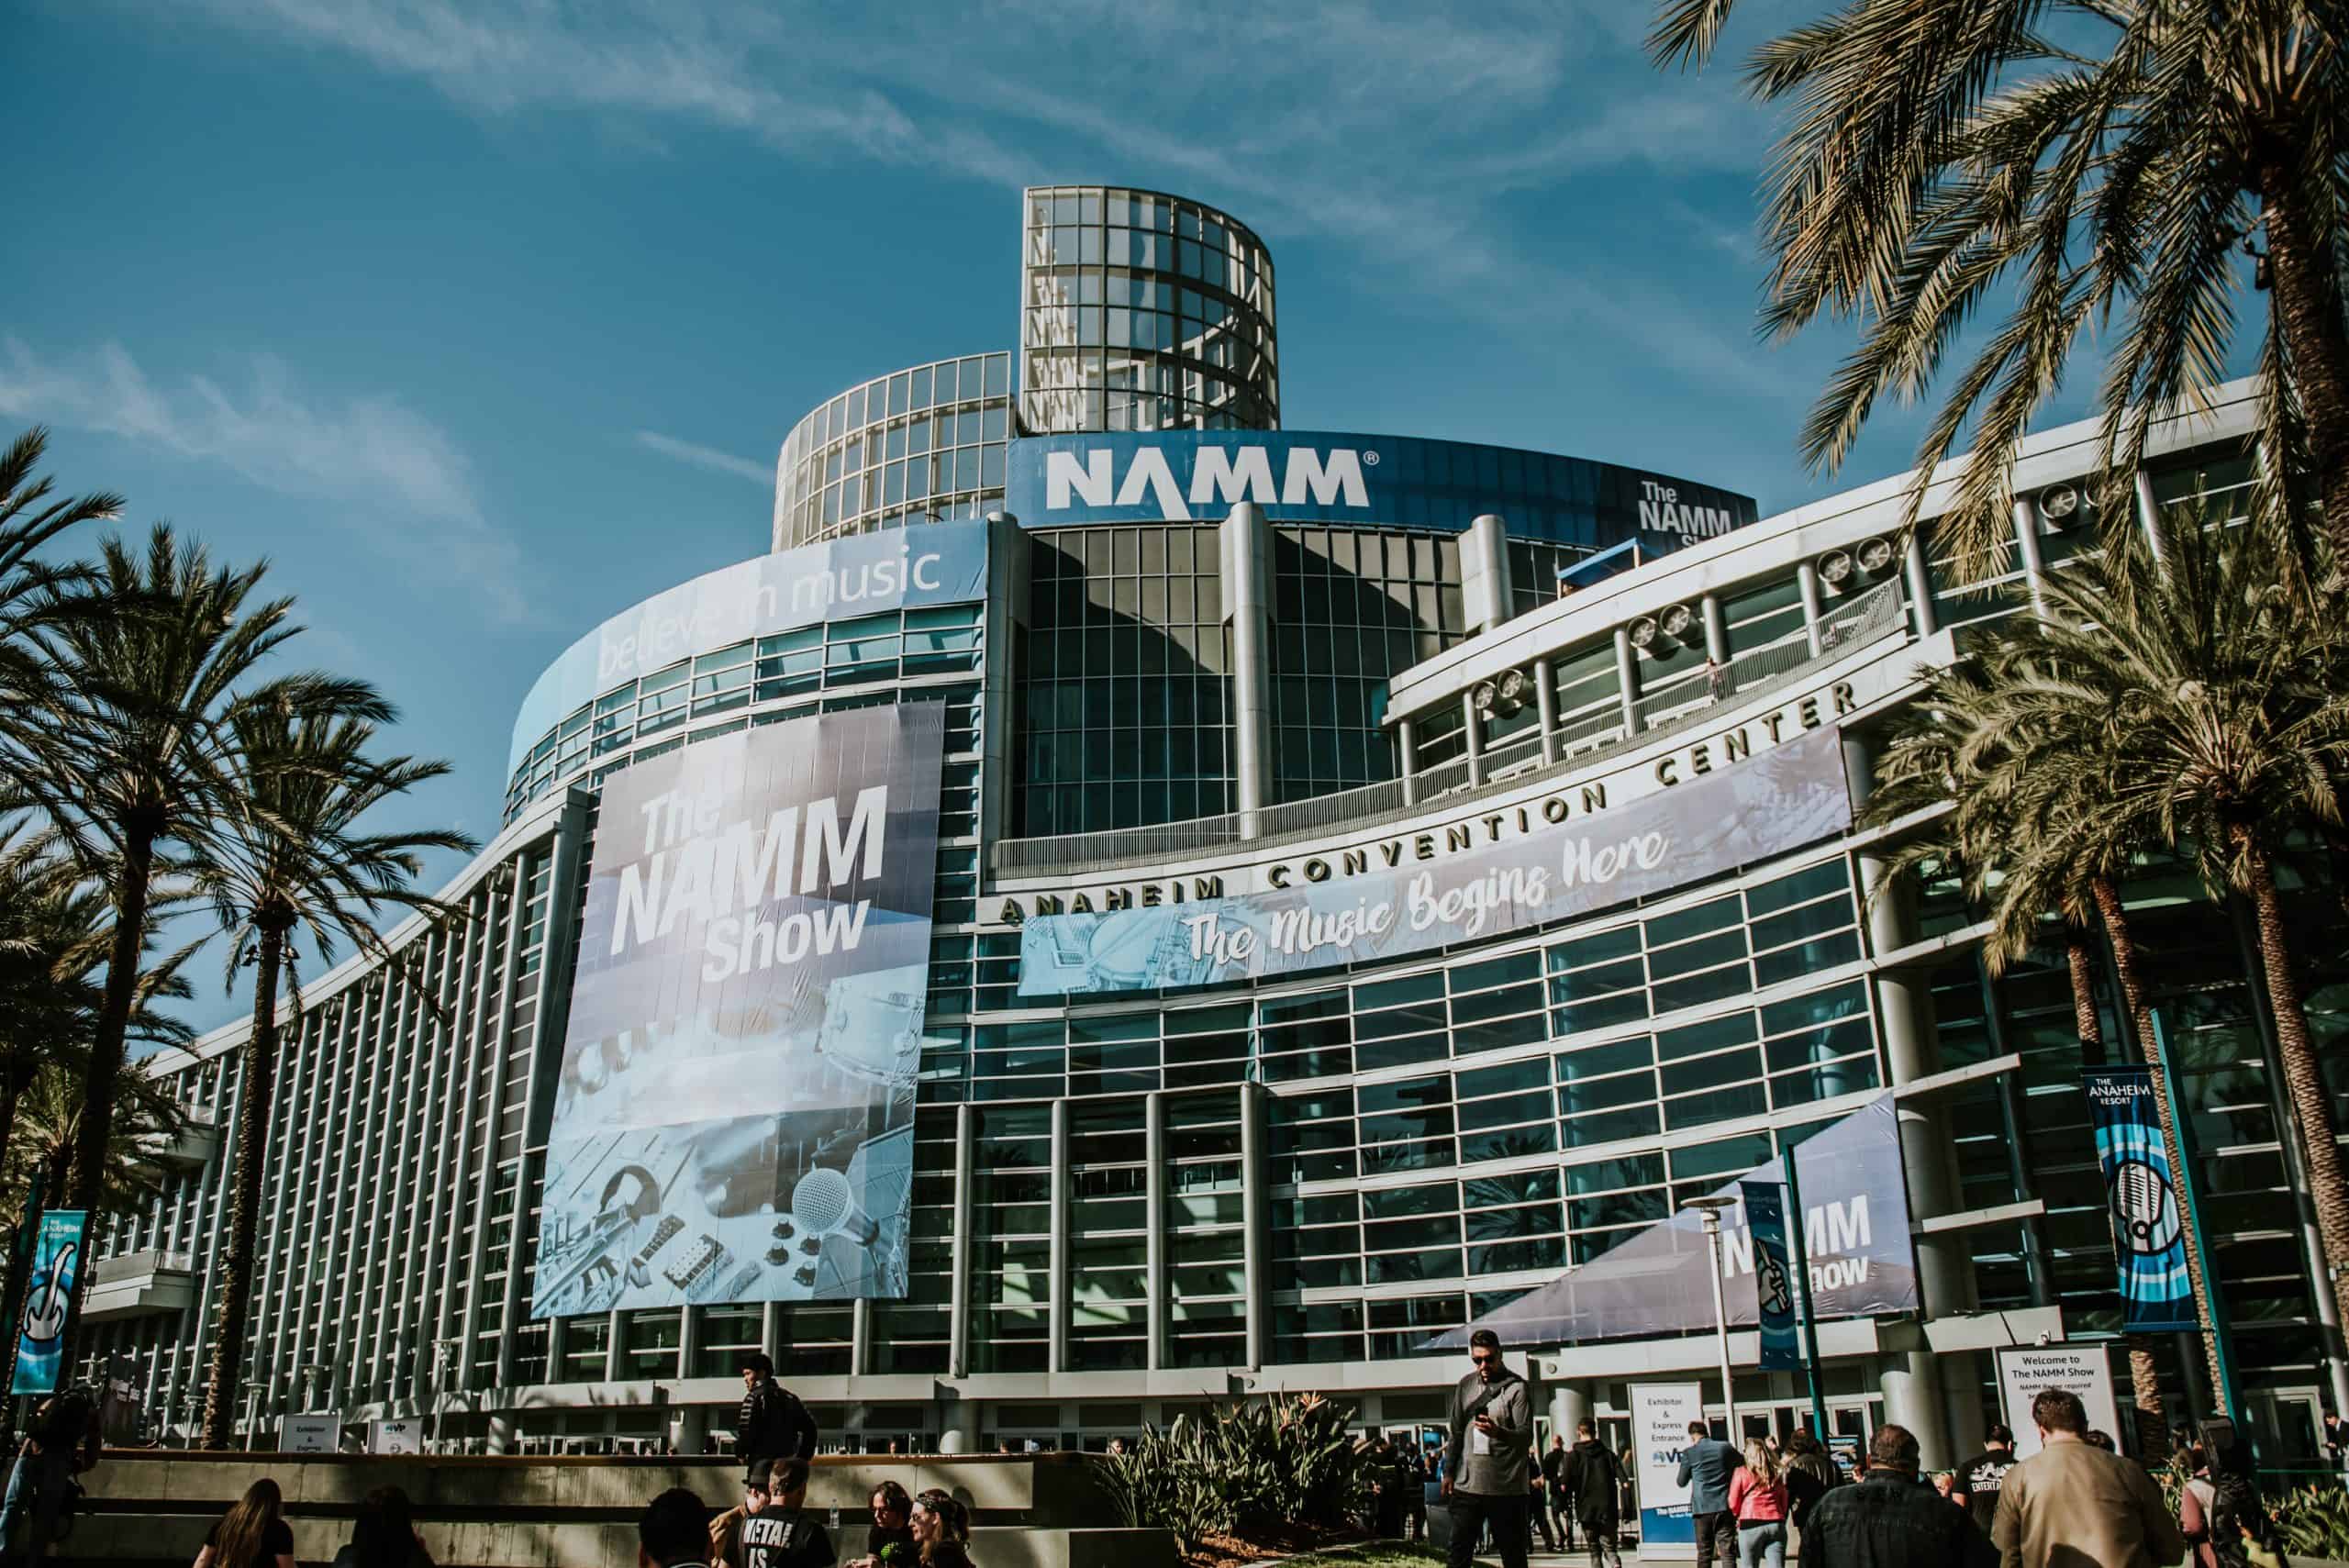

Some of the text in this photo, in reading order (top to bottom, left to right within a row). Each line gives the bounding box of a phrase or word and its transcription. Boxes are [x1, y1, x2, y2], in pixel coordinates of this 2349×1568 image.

[1641, 480, 1678, 504] The
[1638, 499, 1731, 537] NAMM
[599, 604, 721, 677] believe
[792, 544, 941, 612] music
[641, 785, 723, 854] The
[1000, 682, 1857, 927] ANAHEIM CONVENTION CENTER
[610, 784, 888, 955] NAMM
[1183, 829, 1670, 964] The Music Begins Here
[701, 899, 871, 983] Show
[2089, 1084, 2151, 1097] ANAHEIM
[2099, 1096, 2132, 1106] RESORT
[1723, 1195, 1871, 1278] NMM
[2011, 1367, 2095, 1378] The NAMM Show
[2021, 1355, 2080, 1365] Welcome to
[1652, 1434, 1686, 1442] Entrance
[1653, 1421, 1682, 1430] Express
